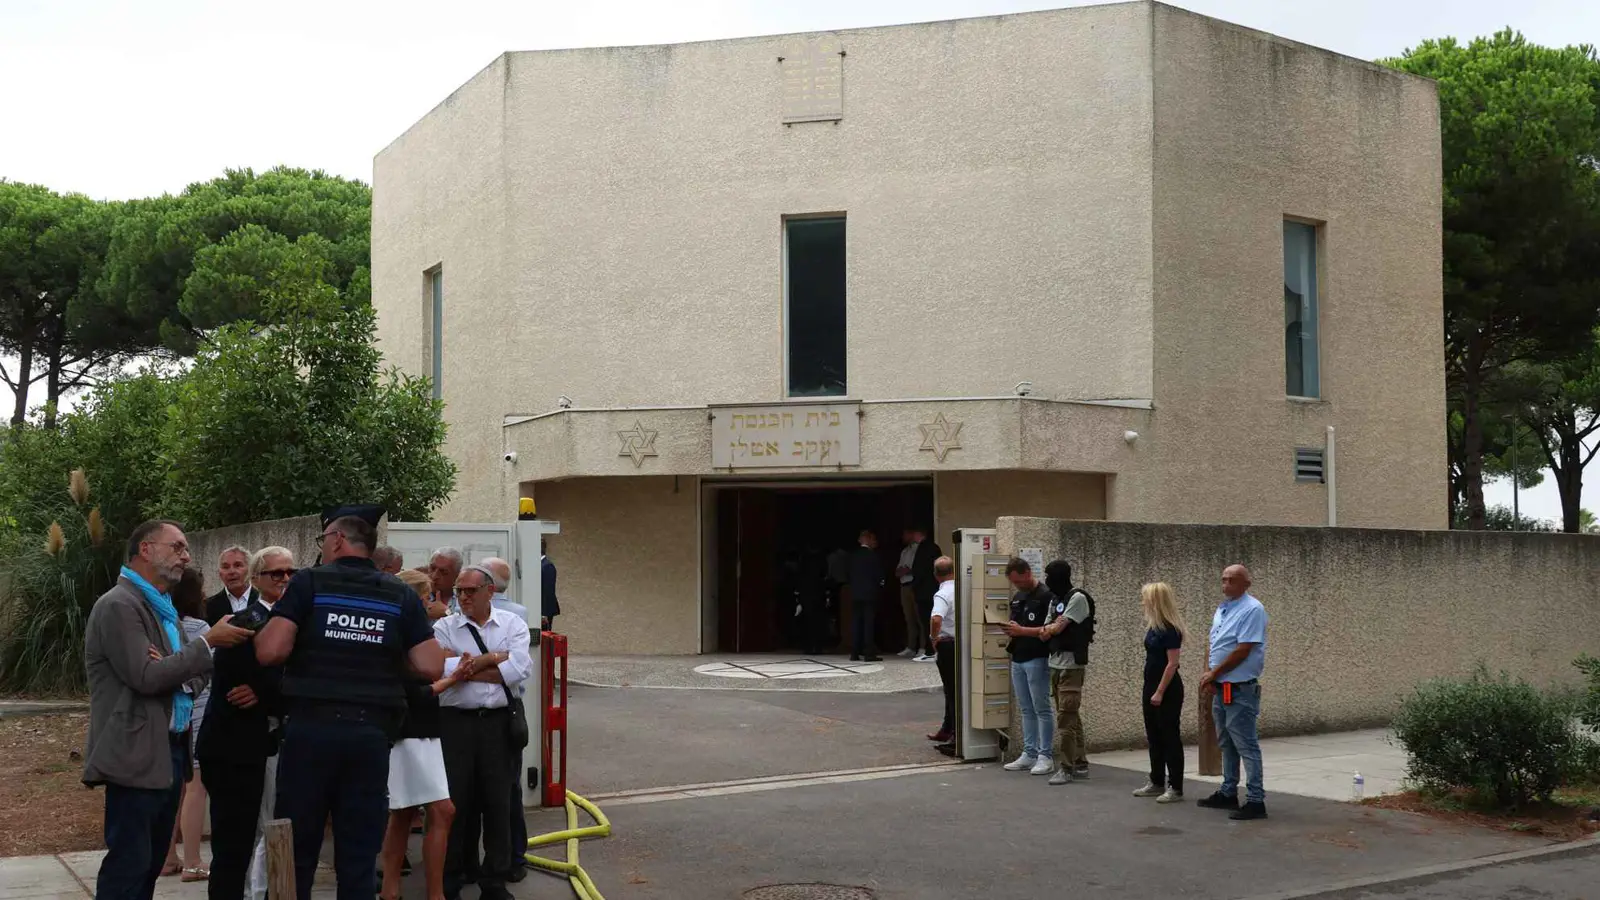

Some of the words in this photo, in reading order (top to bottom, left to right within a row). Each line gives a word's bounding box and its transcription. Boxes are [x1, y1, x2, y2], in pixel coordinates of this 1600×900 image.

[730, 413, 793, 429] הכנסת
[805, 412, 840, 427] בית
[792, 439, 841, 464] יעקב
[326, 613, 385, 631] POLICE
[325, 630, 383, 643] MUNICIPALE
